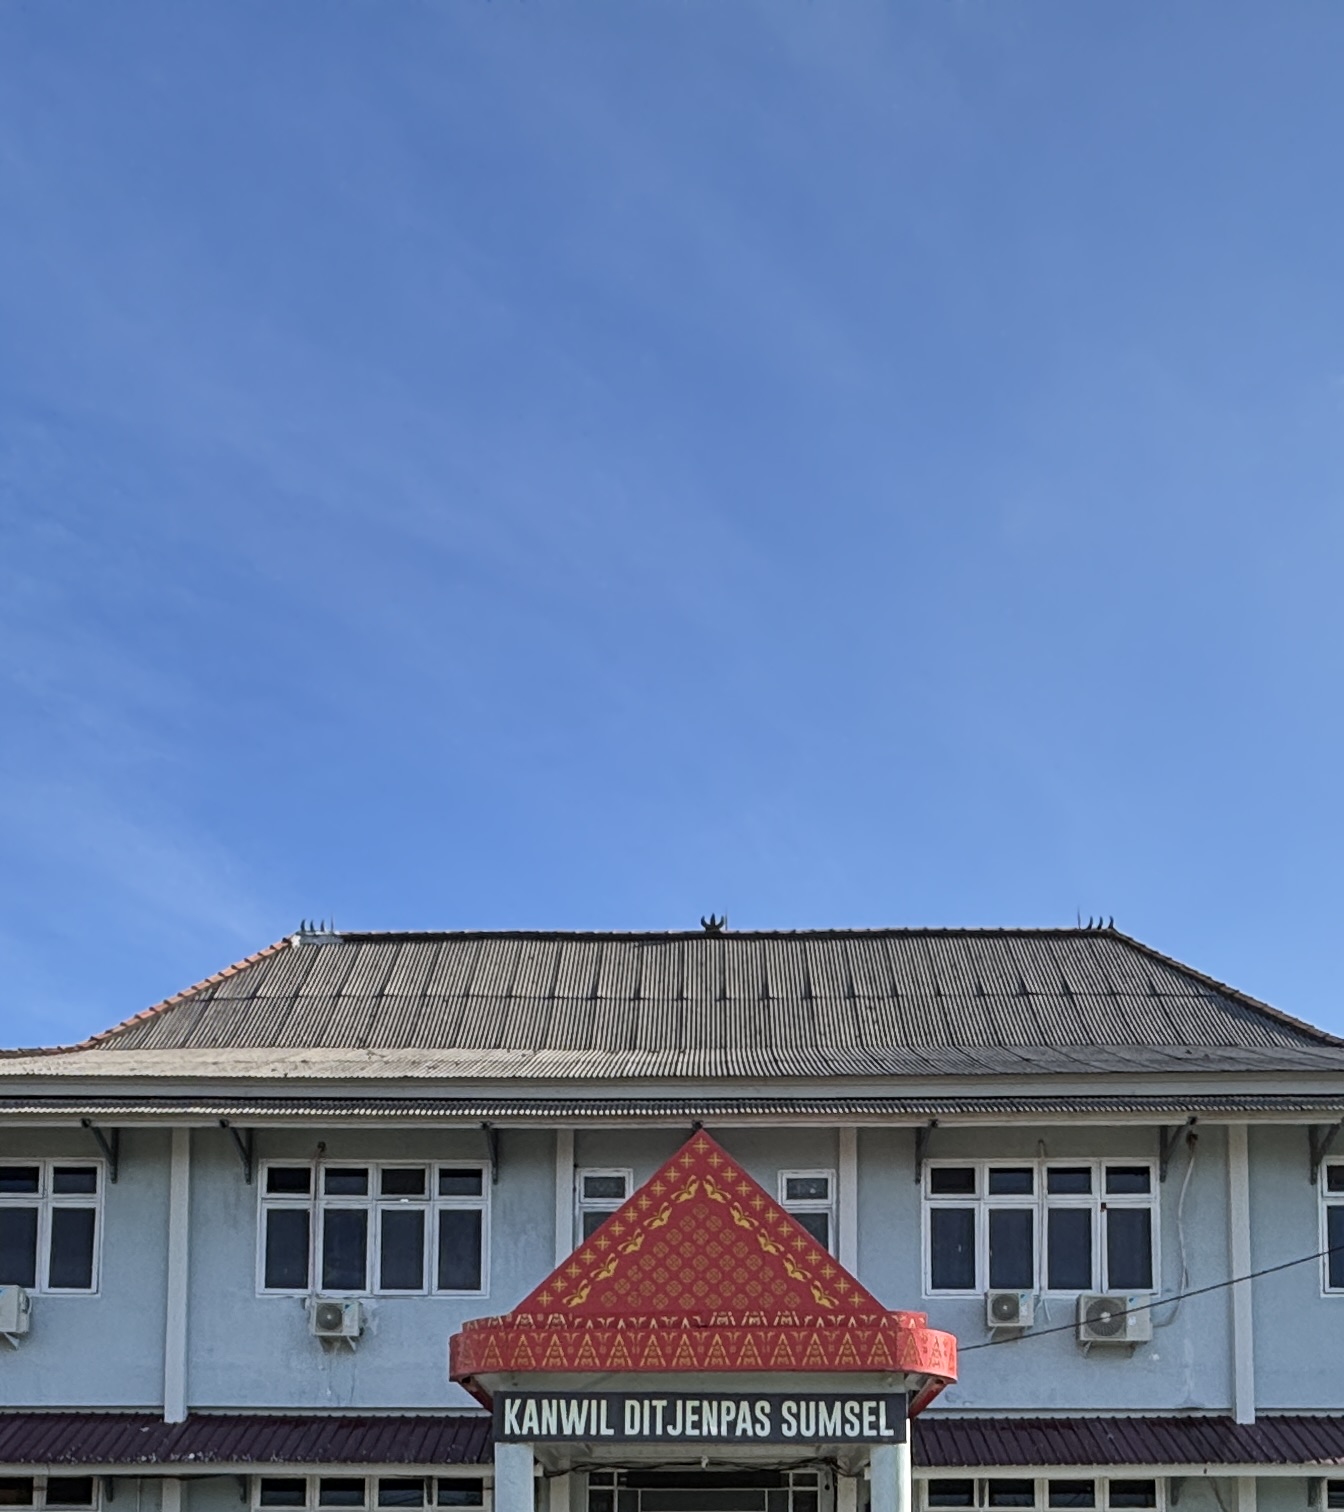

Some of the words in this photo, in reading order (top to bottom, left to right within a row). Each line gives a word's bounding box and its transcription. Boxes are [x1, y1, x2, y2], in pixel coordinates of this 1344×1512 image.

[504, 1398, 614, 1436] KANWIL
[624, 1399, 771, 1437] DITJENPAS
[781, 1400, 894, 1437] SUMSEL
